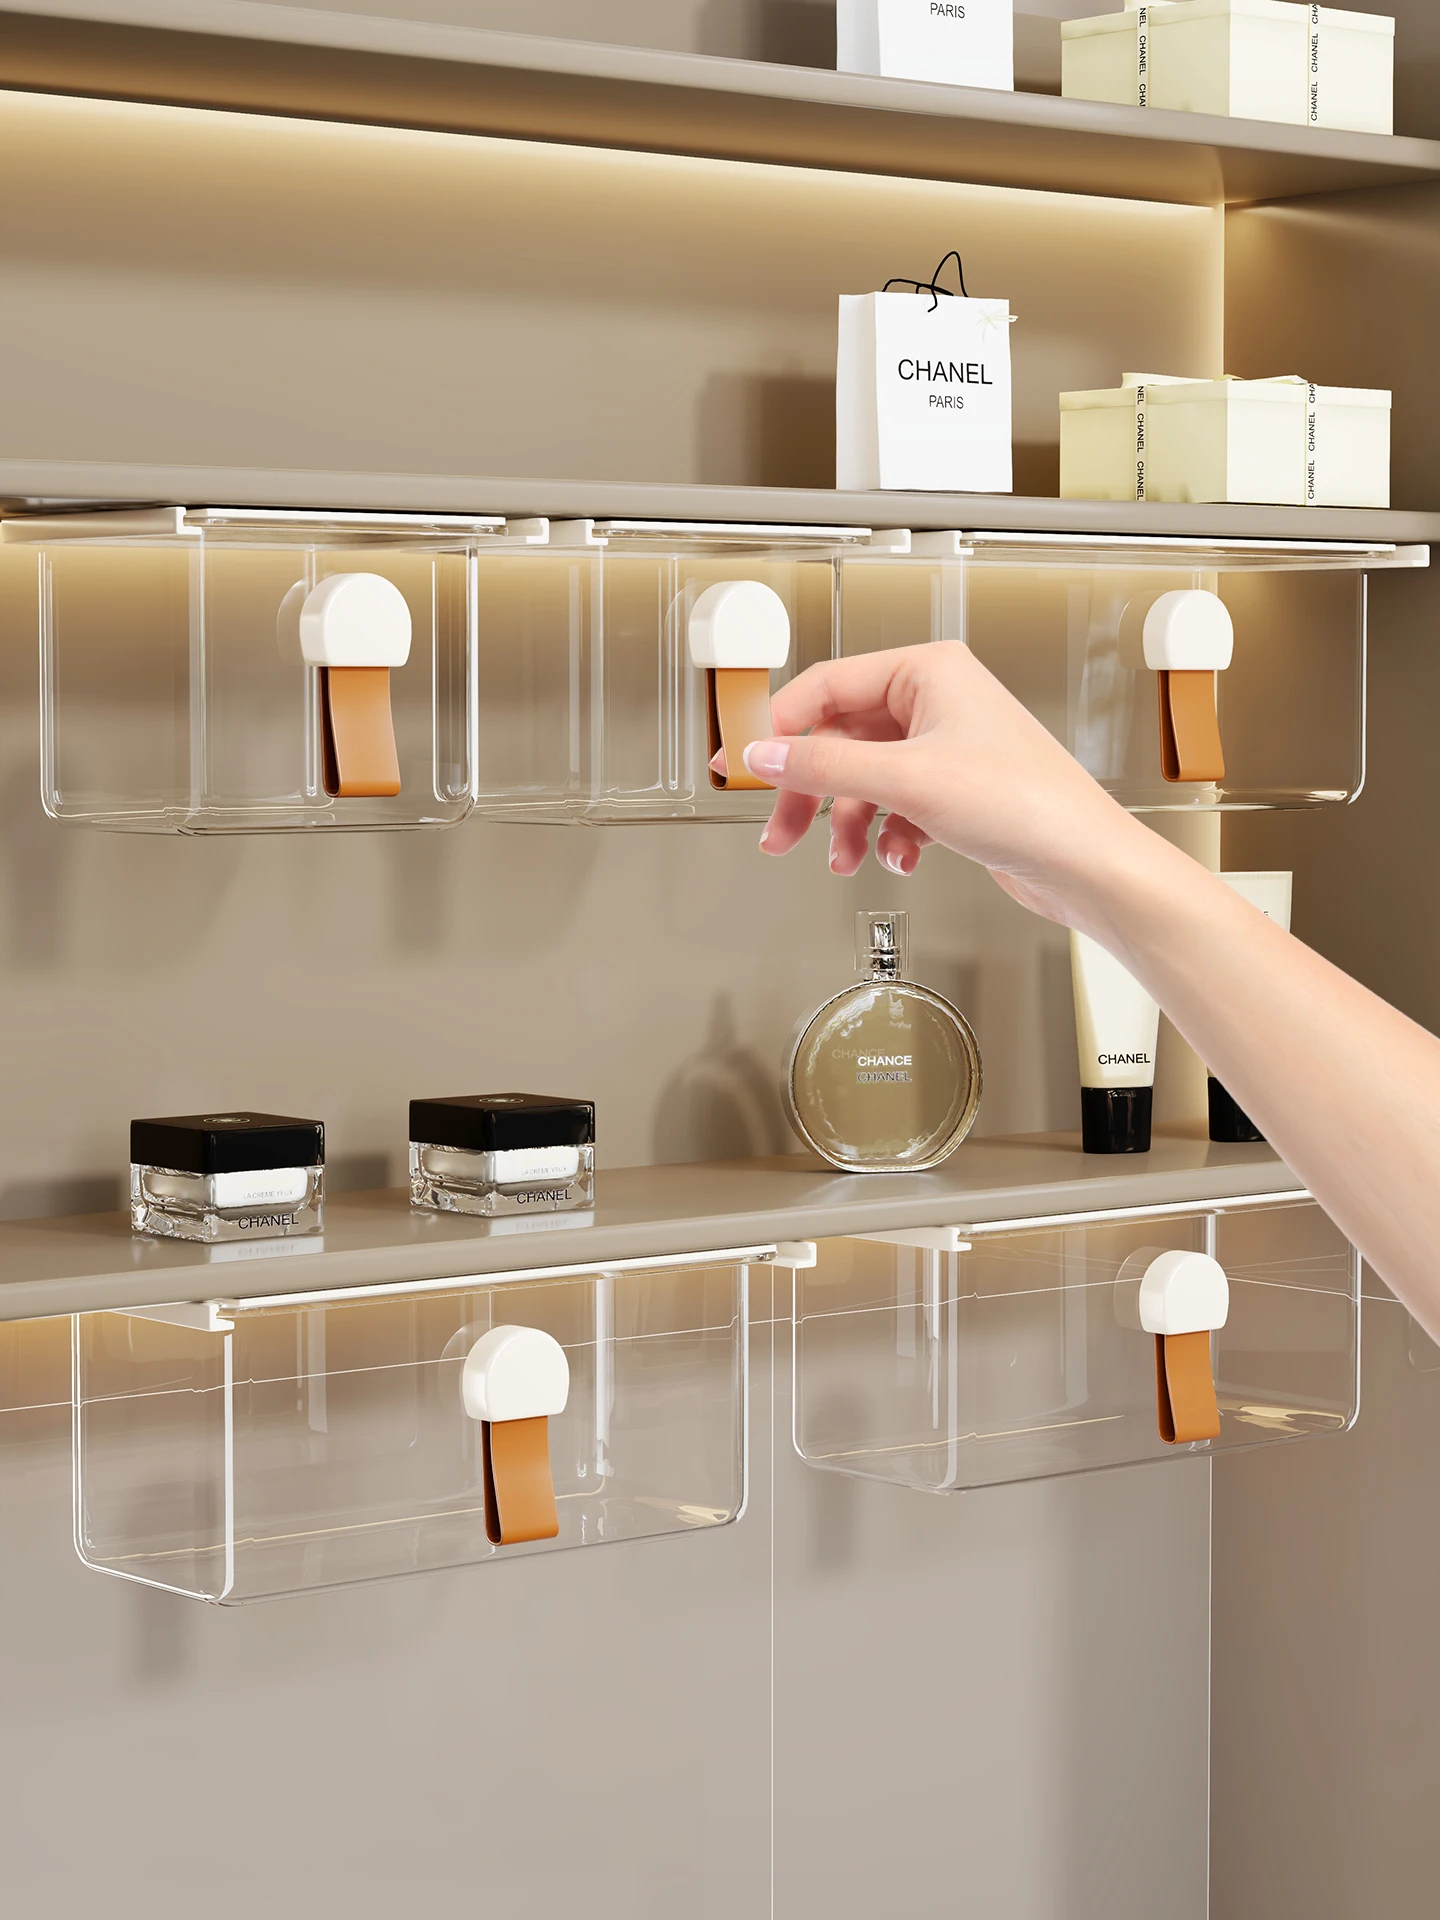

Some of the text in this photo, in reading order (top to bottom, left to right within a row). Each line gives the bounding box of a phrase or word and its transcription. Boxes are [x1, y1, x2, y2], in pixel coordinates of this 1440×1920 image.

[930, 2, 966, 19] PARIS
[1138, 35, 1147, 76] CHANEL
[1310, 33, 1319, 73] CHANEL
[1310, 81, 1318, 121] CHANEL
[898, 358, 993, 385] CHANEL
[929, 394, 964, 410] PARIS
[1136, 413, 1145, 453] CHANEL
[1307, 411, 1316, 452] CHANEL
[1136, 461, 1145, 501] CHANEL
[1307, 459, 1315, 500] CHANEL
[857, 1055, 913, 1067] CHANCE
[1097, 1053, 1151, 1065] CHANEL
[857, 1071, 913, 1083] CHANEL
[516, 1188, 572, 1205] CHANEL
[238, 1213, 299, 1230] CHANEL
